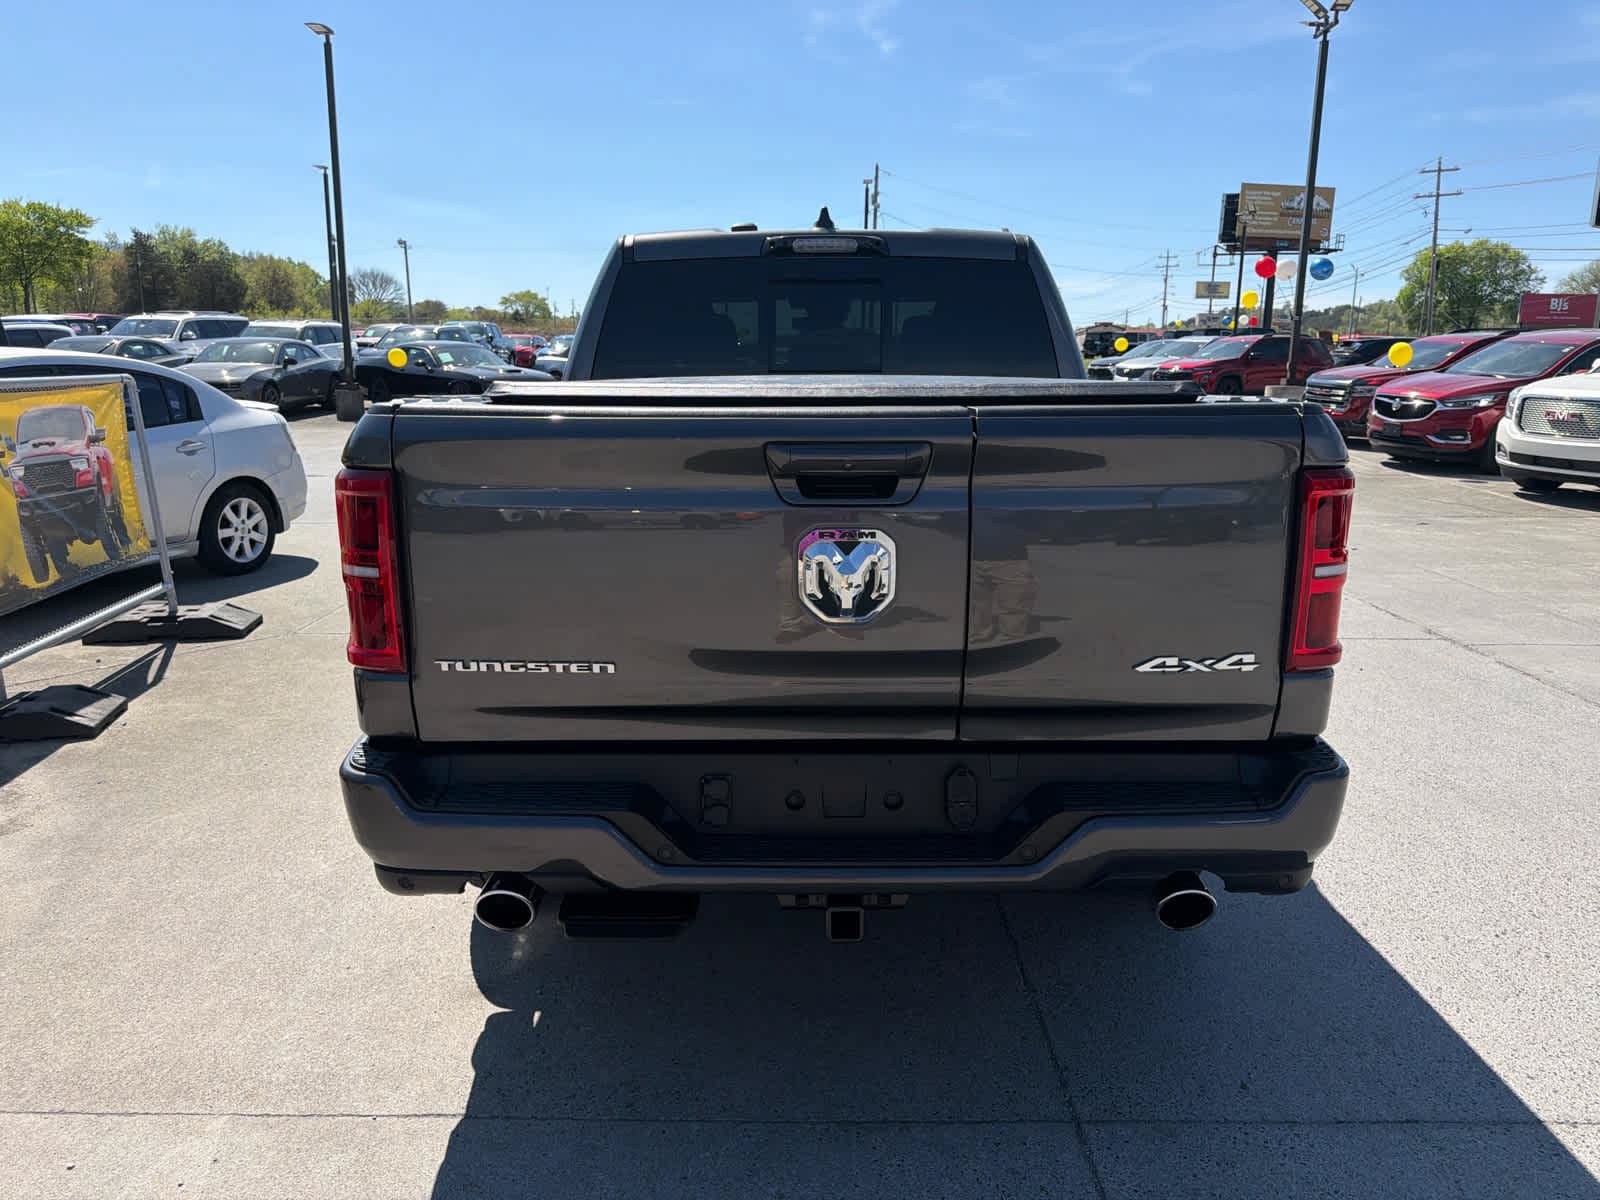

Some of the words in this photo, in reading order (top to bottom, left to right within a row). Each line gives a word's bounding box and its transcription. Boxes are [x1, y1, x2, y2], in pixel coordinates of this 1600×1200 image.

[1543, 410, 1583, 421] GMC
[818, 531, 877, 539] RAM
[434, 659, 616, 673] TUNGSTEN
